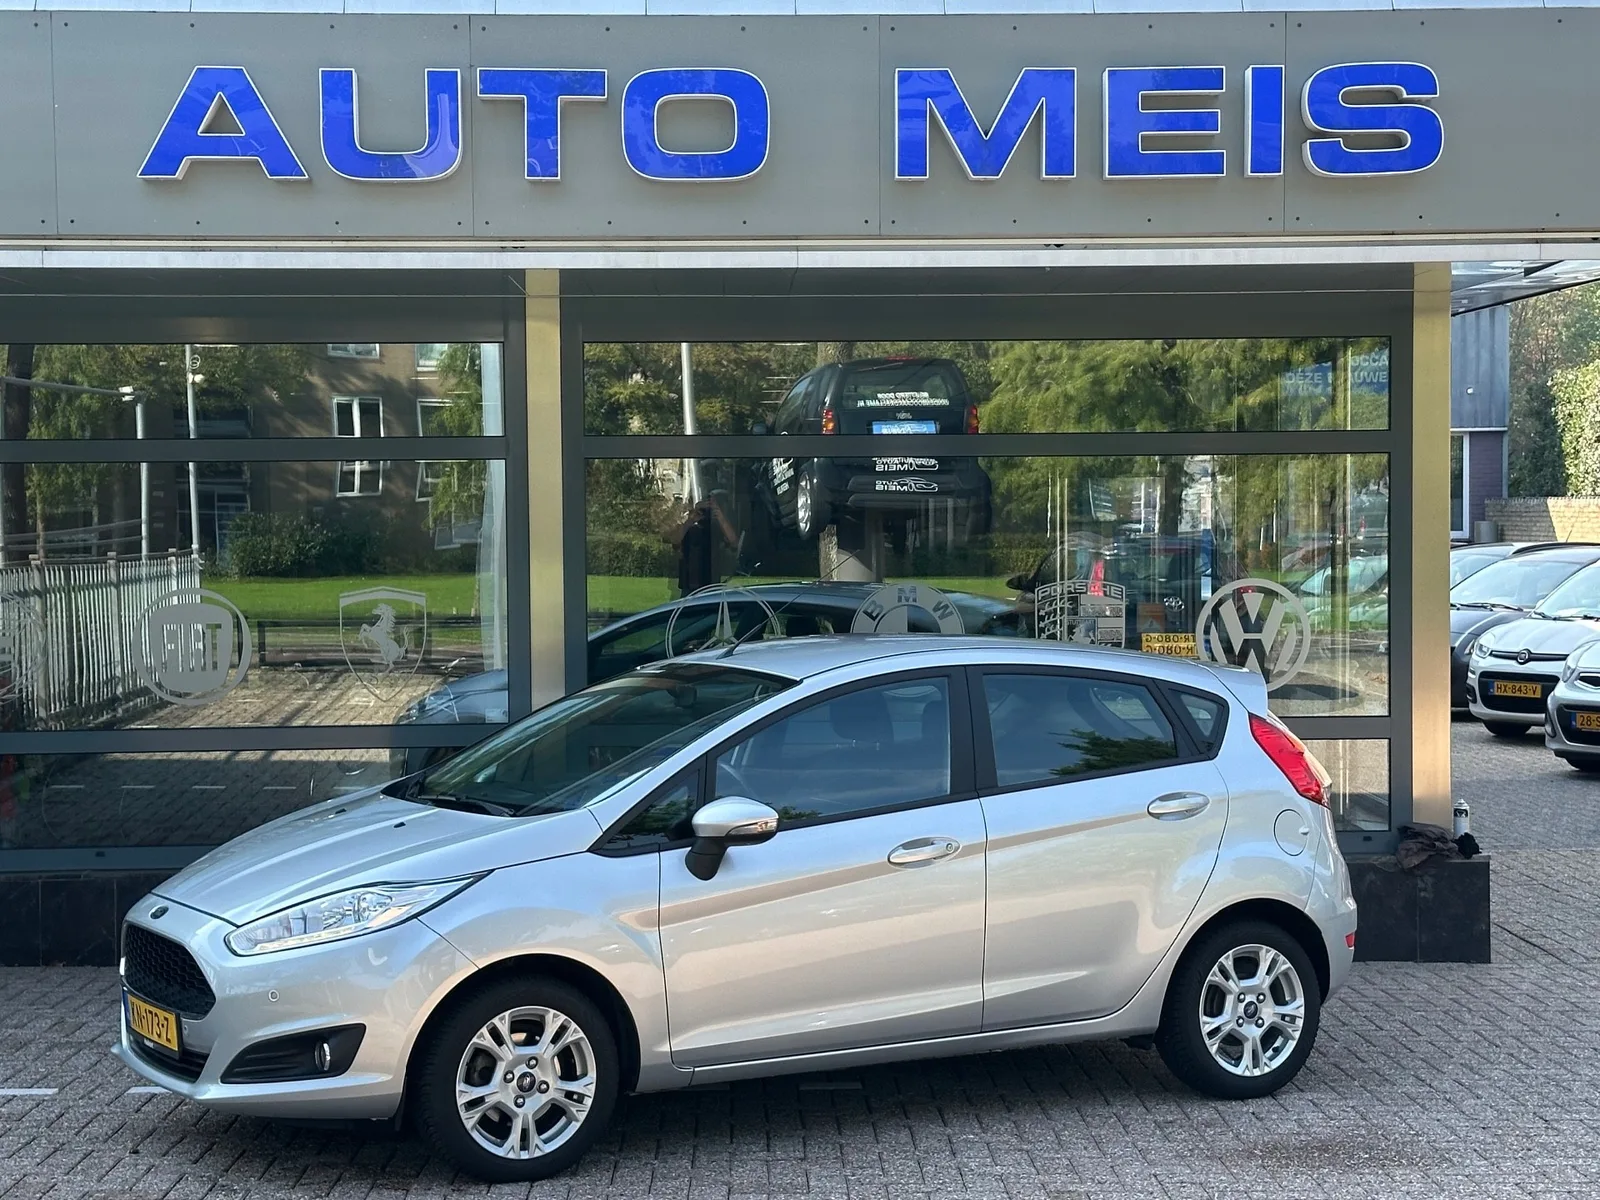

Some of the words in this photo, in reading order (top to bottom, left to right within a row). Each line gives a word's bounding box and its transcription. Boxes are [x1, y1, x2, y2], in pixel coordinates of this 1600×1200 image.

[136, 65, 771, 183] AUTO
[894, 61, 1445, 182] MEIS
[1285, 372, 1322, 384] DEZE
[861, 585, 954, 622] BMW
[160, 623, 223, 672] FIAT
[1496, 683, 1538, 696] HX-843-V
[1579, 714, 1600, 728] 28-S
[130, 1000, 172, 1044] KN-173-Z
